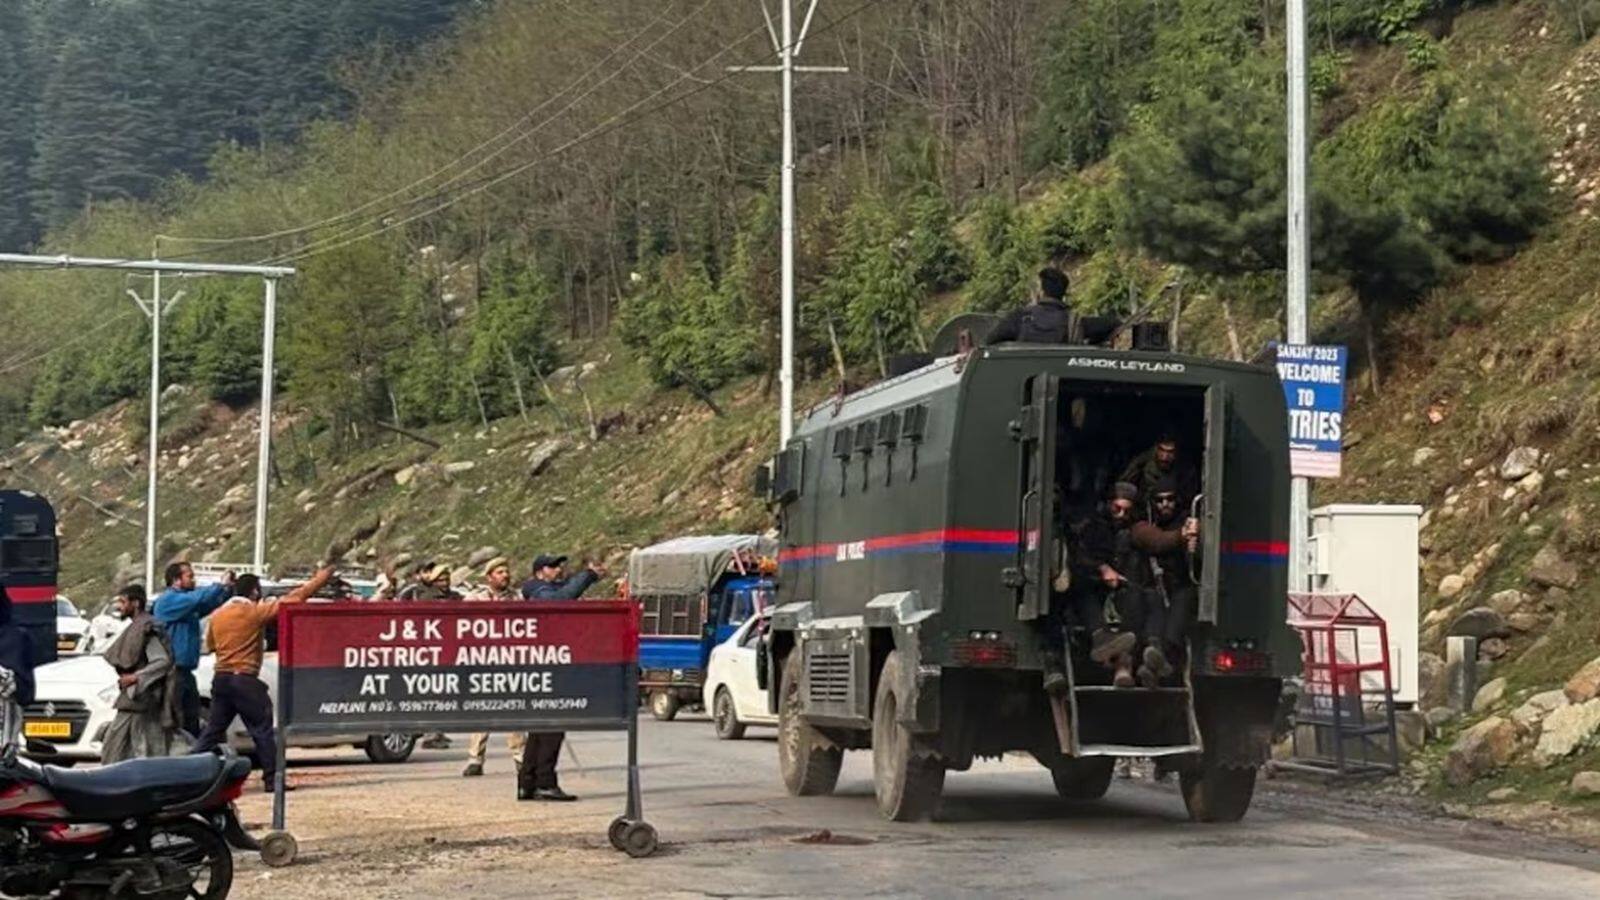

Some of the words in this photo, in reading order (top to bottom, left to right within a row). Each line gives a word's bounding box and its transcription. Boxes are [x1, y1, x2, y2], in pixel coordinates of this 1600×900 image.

[1067, 357, 1118, 369] ASHOK
[1120, 360, 1186, 373] LEYLAND
[1297, 388, 1315, 406] TO
[456, 618, 538, 640] POLICE
[344, 646, 443, 668] DISTRICT
[454, 645, 572, 666] ANANTNAG
[359, 674, 390, 696] AT
[402, 673, 460, 695] YOUR
[468, 671, 553, 694] SERVICE
[318, 701, 367, 714] HELPLINE
